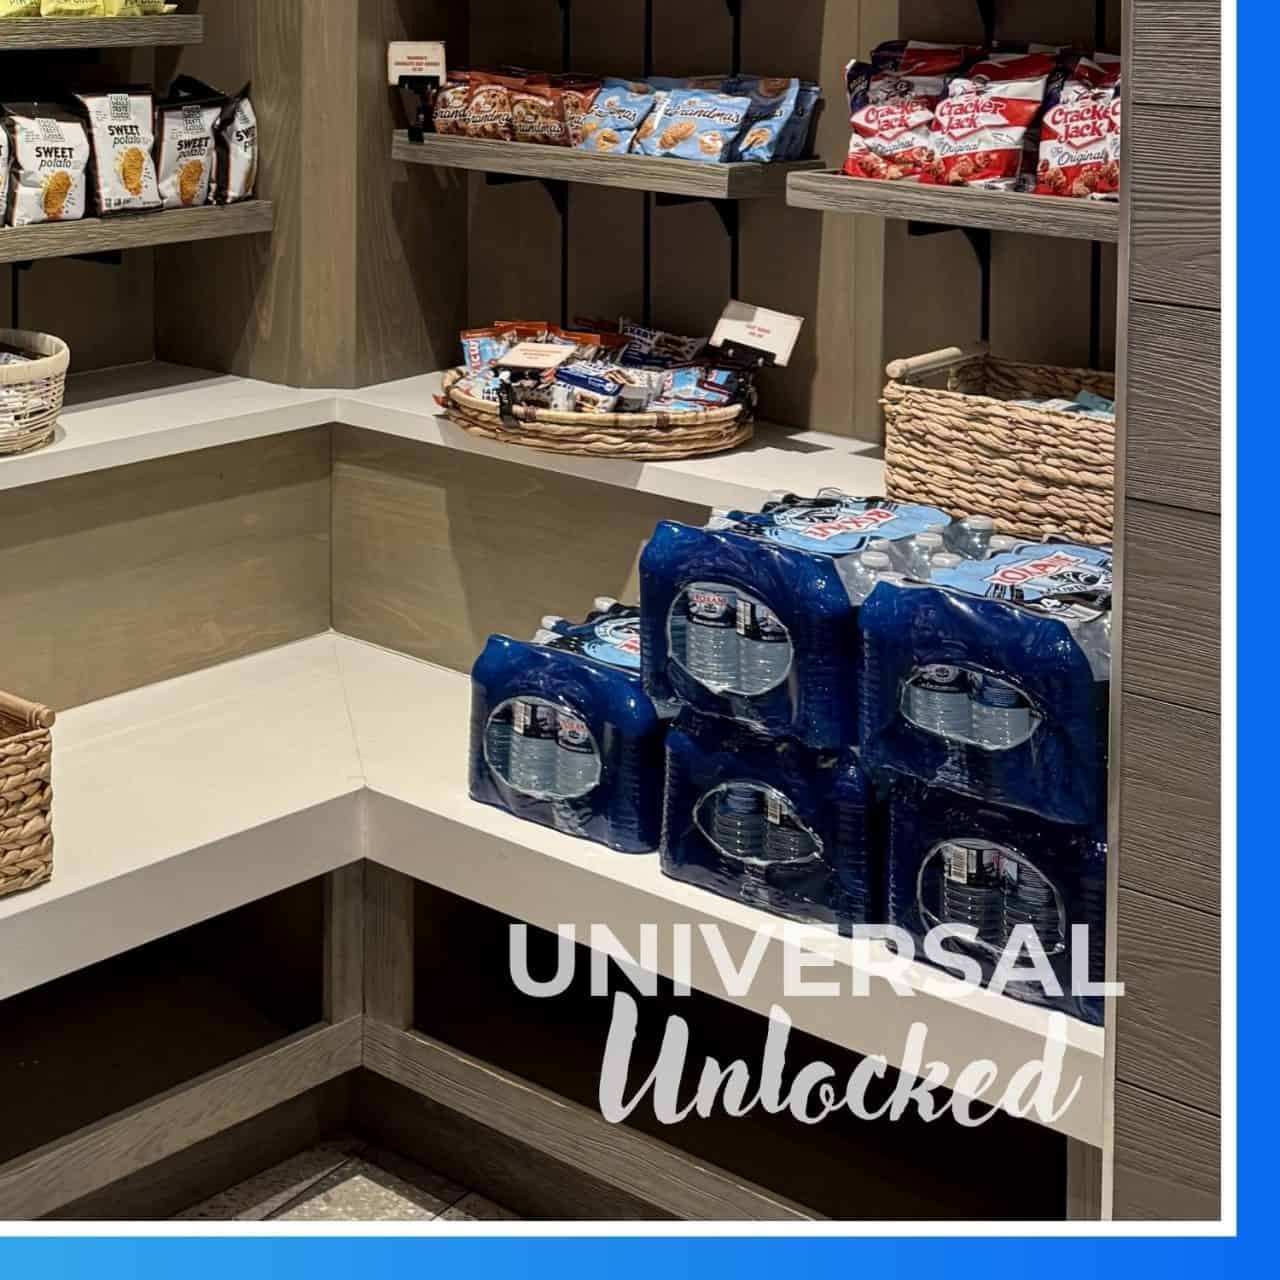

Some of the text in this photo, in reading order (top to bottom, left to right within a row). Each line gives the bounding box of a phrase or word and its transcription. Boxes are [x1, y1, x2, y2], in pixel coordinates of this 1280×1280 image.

[940, 99, 1006, 117] Cracker
[107, 124, 141, 137] SWEET
[942, 116, 981, 134] Jack
[1057, 120, 1103, 143] Jack
[176, 136, 211, 151] SWEET
[35, 146, 74, 160] SWEET
[38, 156, 72, 170] potato
